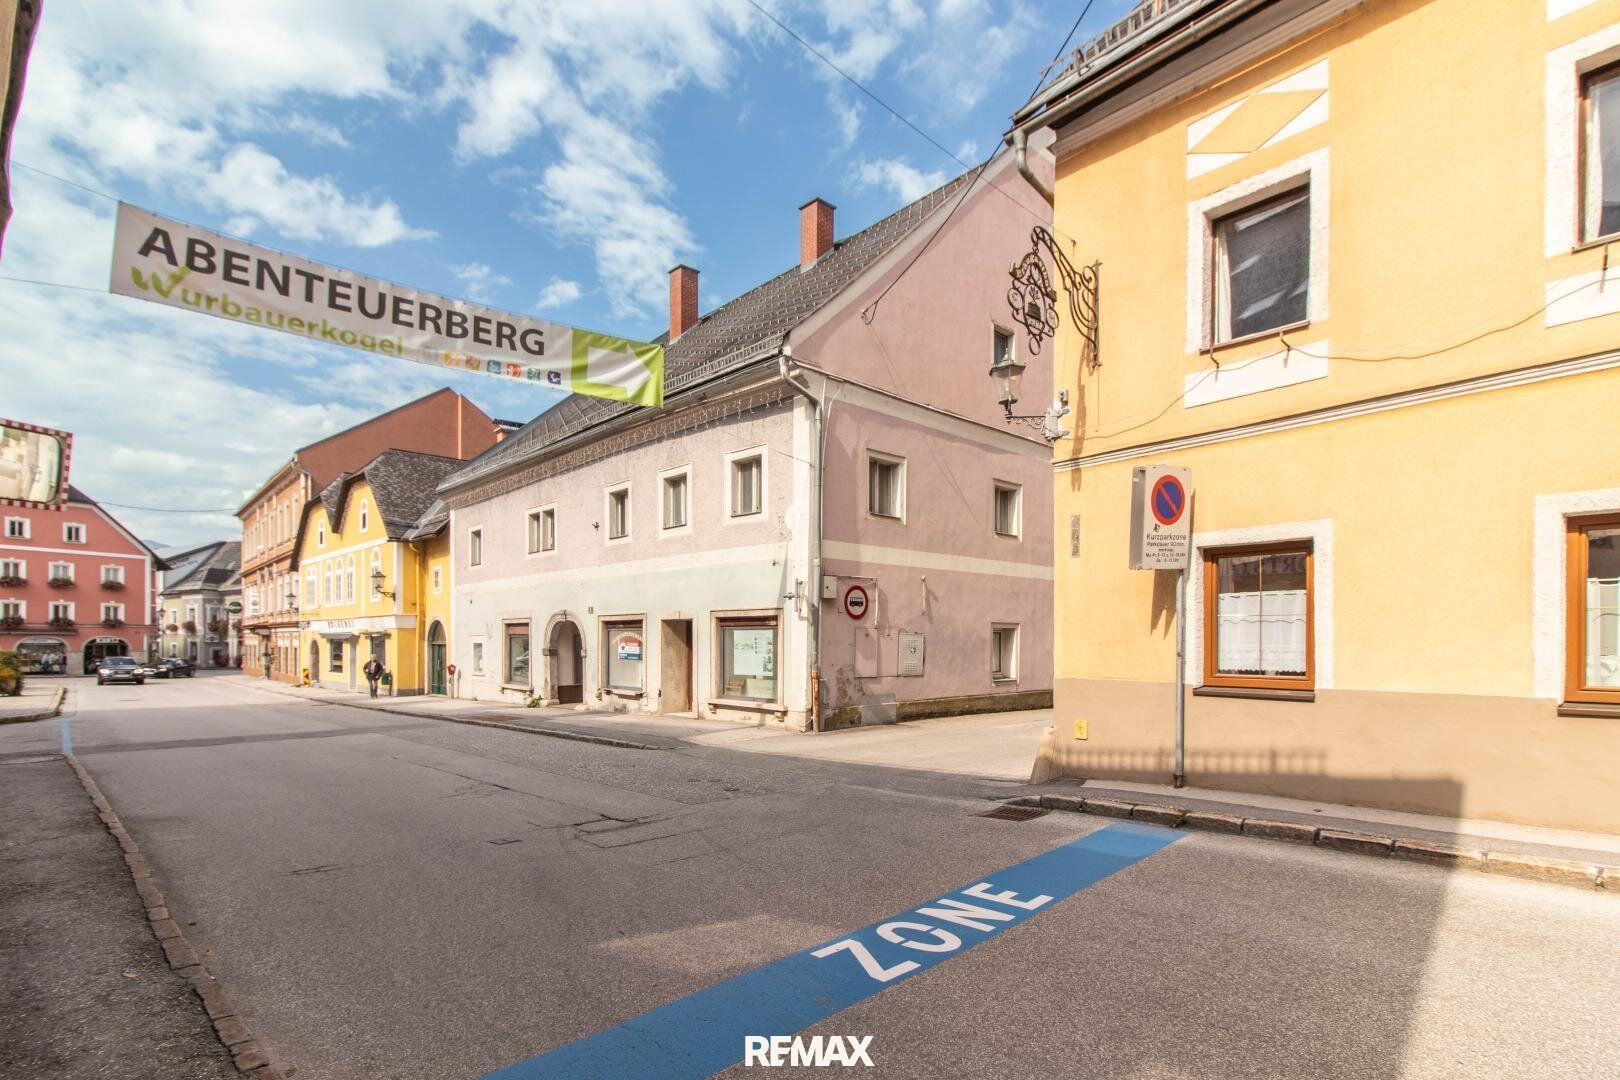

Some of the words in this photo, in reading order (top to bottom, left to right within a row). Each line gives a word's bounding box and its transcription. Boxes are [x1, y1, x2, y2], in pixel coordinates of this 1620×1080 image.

[137, 226, 546, 357] ABENTEUERBERG
[1147, 533, 1187, 541] Kurzparkzone
[810, 882, 1055, 983] ZONE
